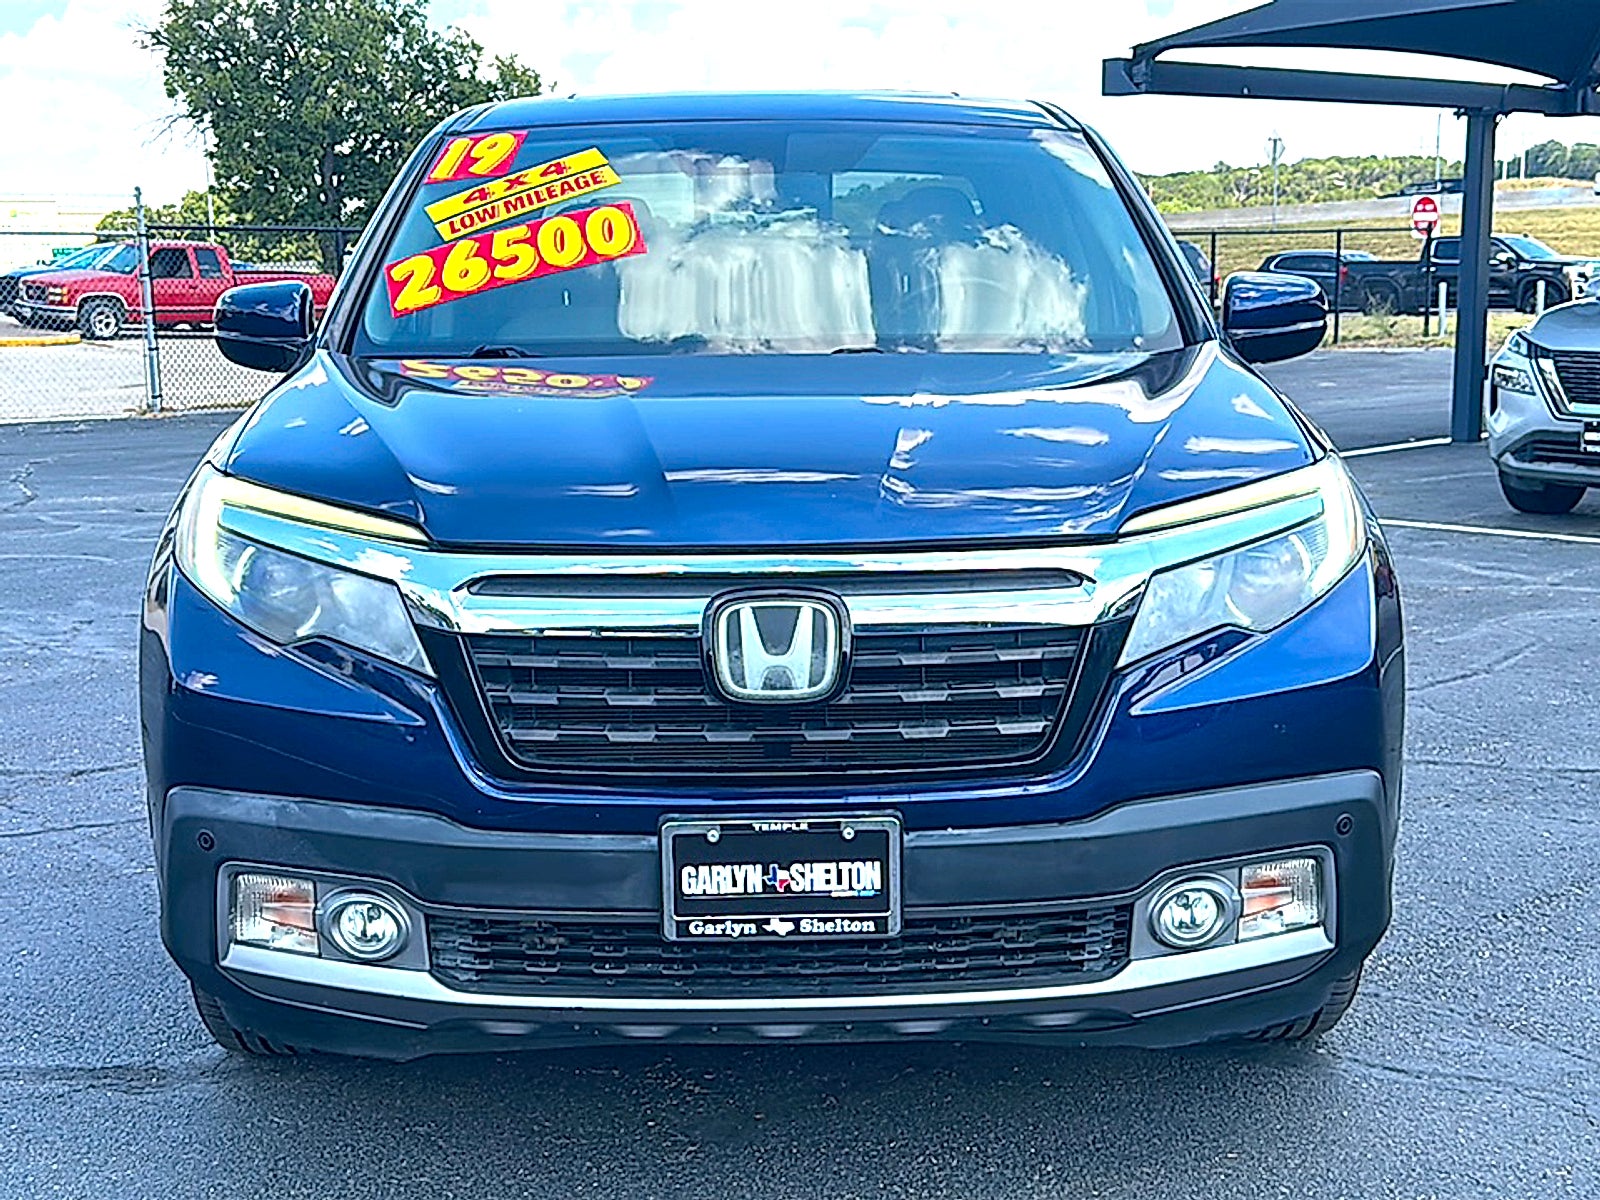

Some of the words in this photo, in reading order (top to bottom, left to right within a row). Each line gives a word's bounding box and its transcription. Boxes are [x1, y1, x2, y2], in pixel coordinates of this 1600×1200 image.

[429, 131, 519, 180] 19
[448, 204, 500, 235] LOW
[503, 170, 608, 215] MILEAGE
[389, 206, 637, 312] 26500
[752, 822, 809, 832] TEMPLE
[681, 863, 763, 895] GARLYN
[789, 861, 882, 892] SHELTON
[688, 920, 758, 939] Garlyn
[799, 918, 876, 934] Shelton
